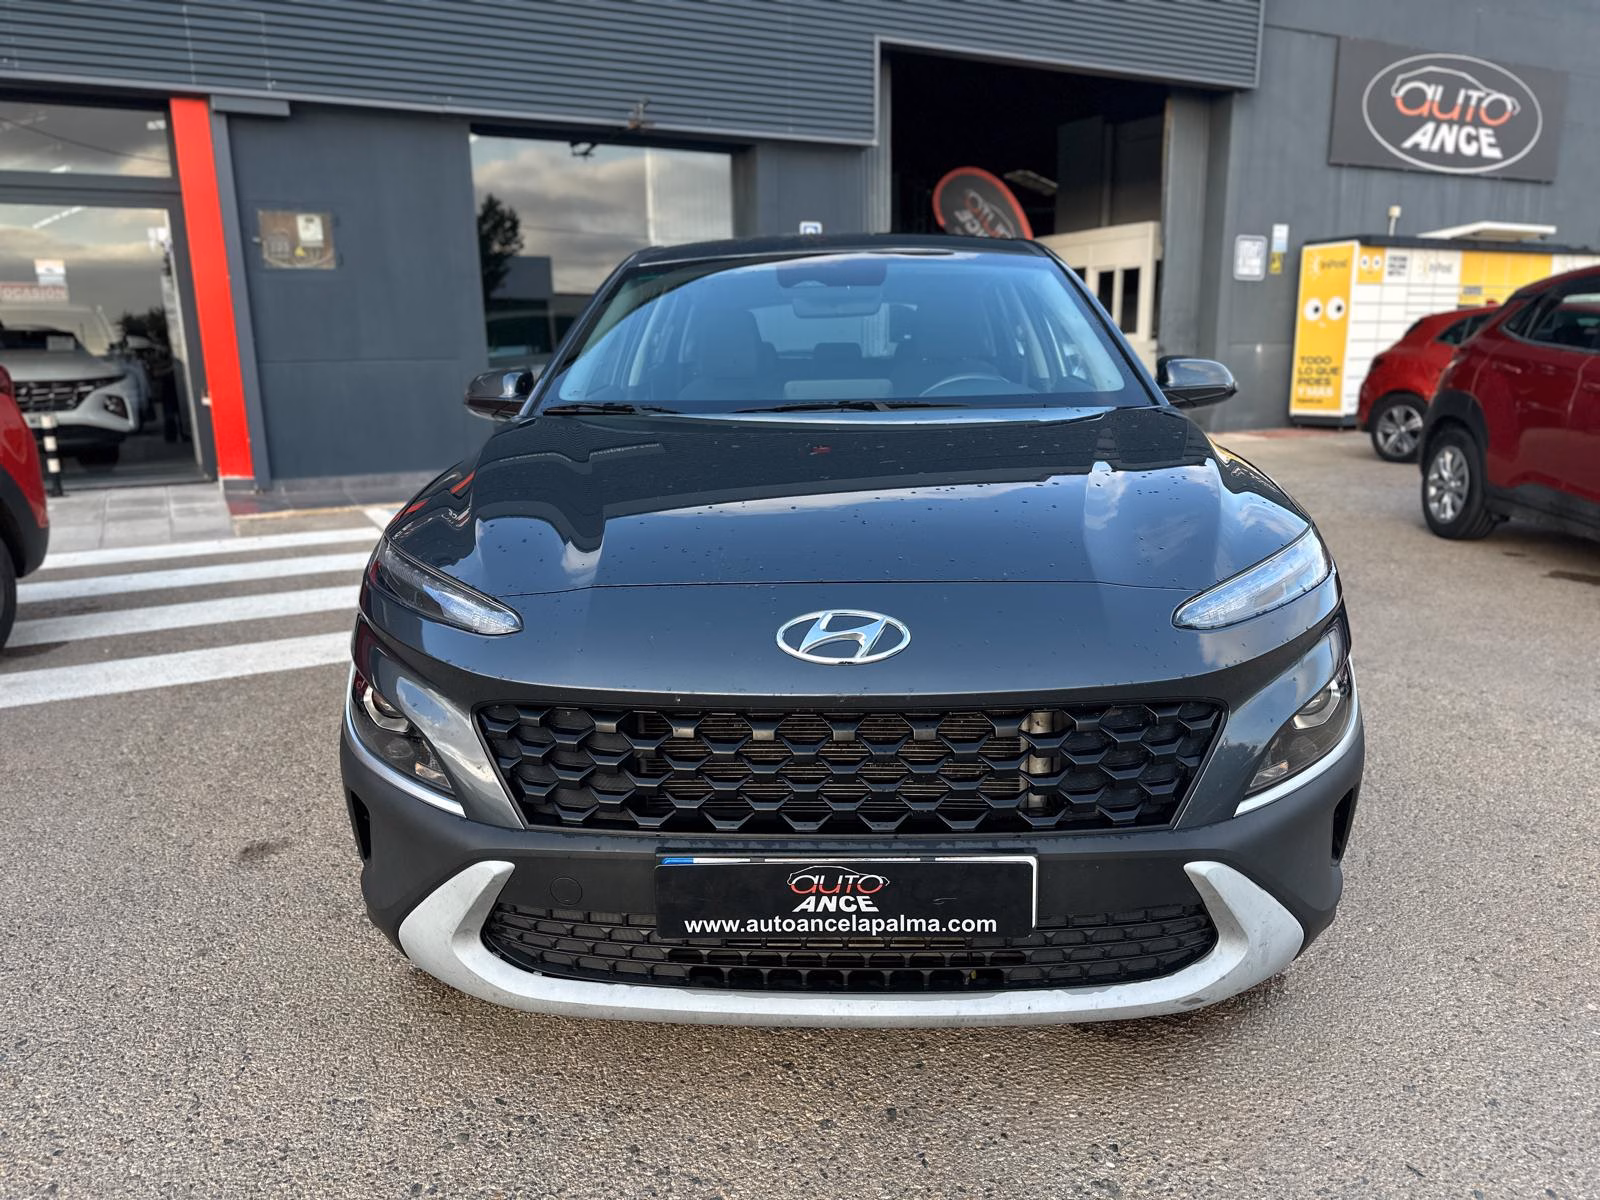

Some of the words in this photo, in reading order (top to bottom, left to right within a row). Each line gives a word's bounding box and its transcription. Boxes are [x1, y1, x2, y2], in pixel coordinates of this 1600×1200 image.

[1401, 121, 1503, 159] ANCE
[1300, 355, 1333, 365] TODO
[1297, 366, 1313, 376] LO
[1315, 366, 1339, 376] QUE
[792, 895, 880, 913] ANCE
[684, 914, 997, 936] www.autoancelapalma.com
